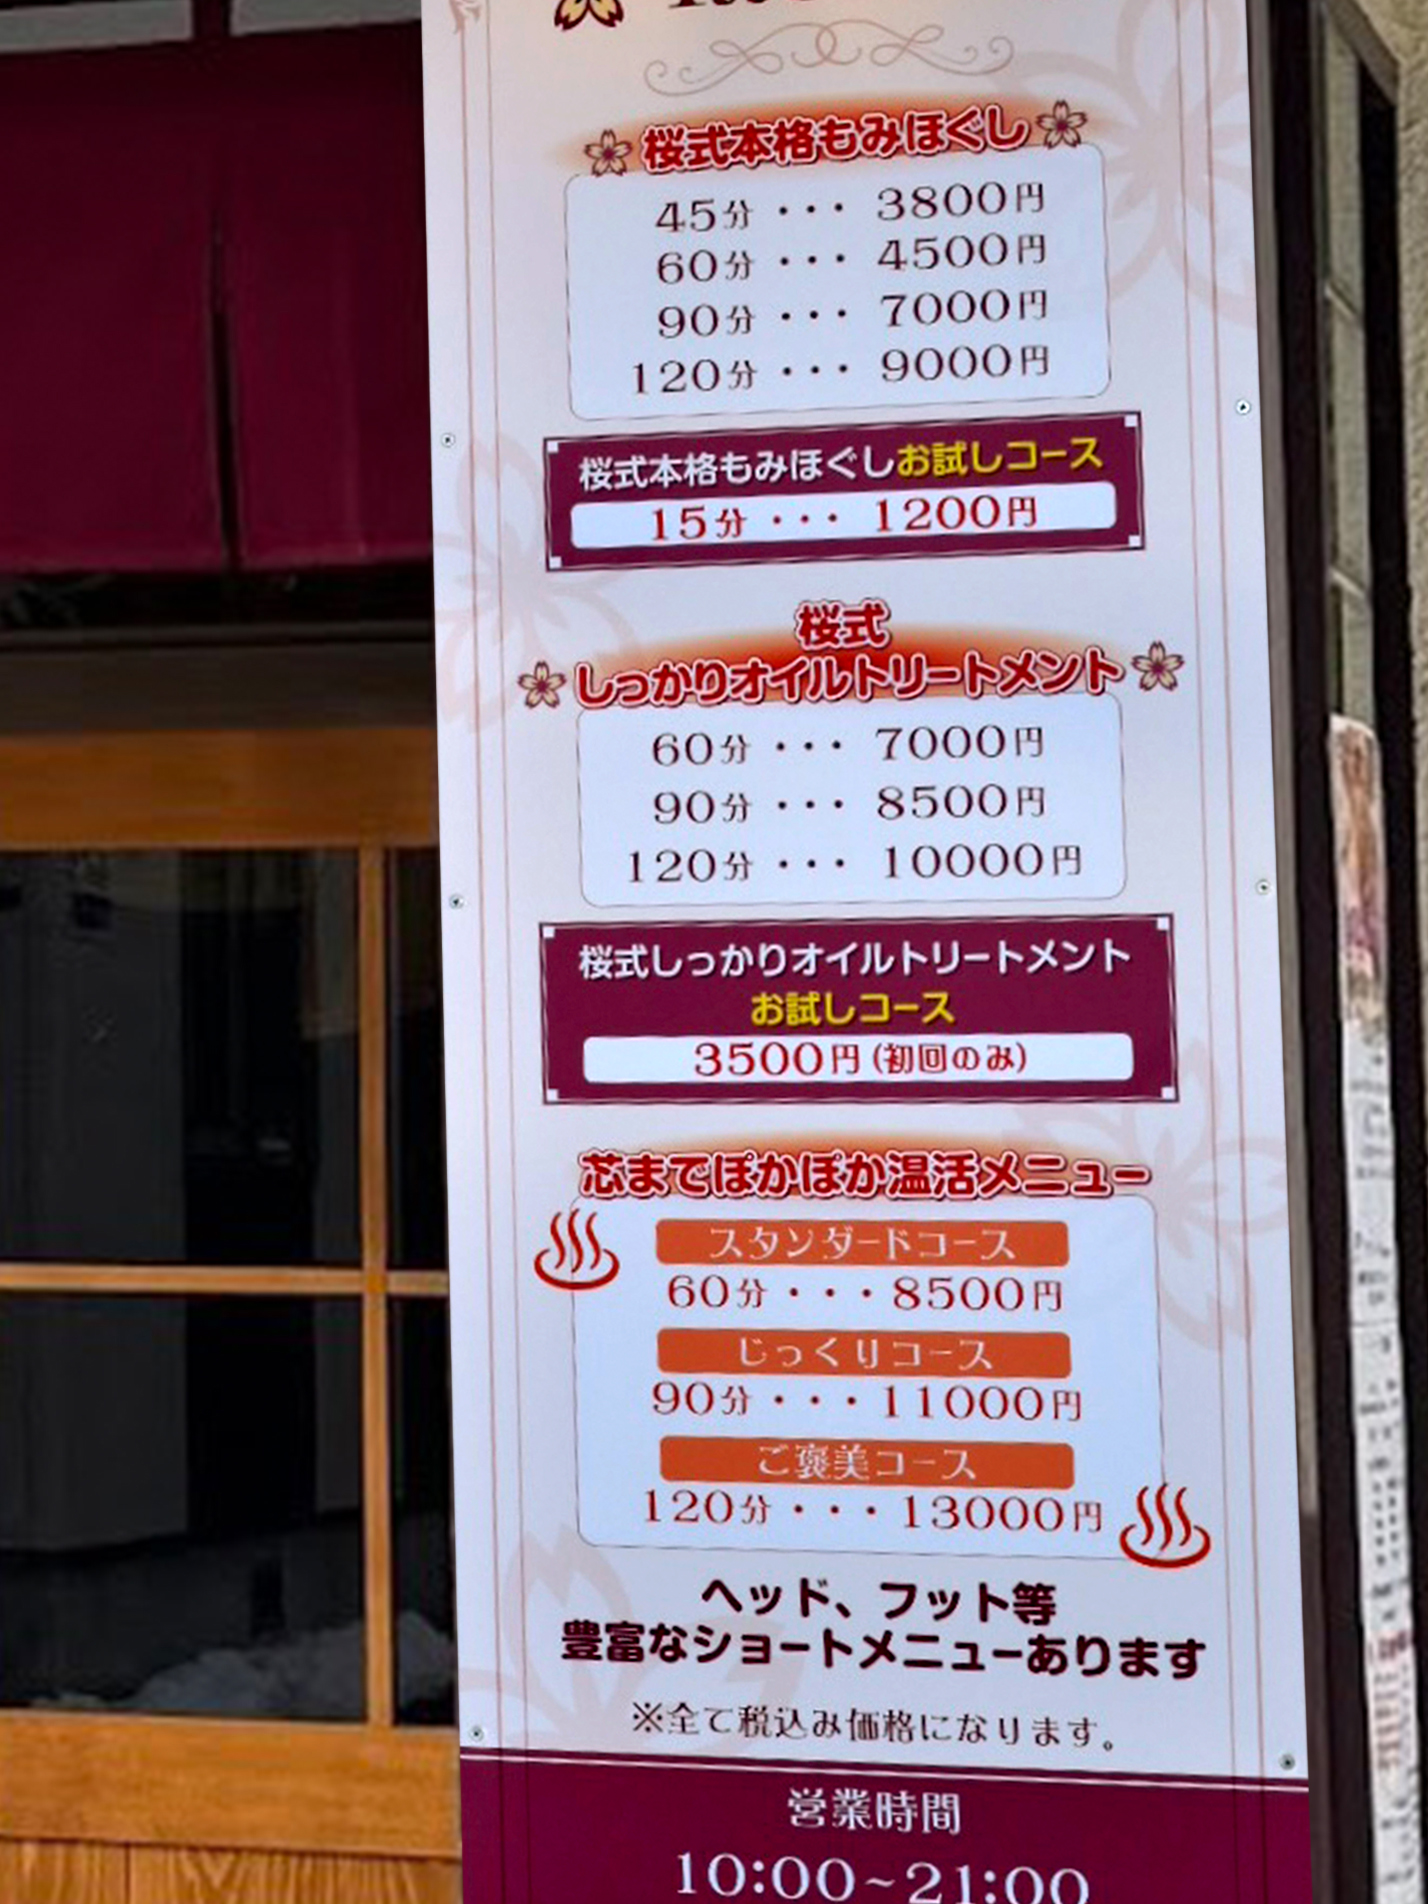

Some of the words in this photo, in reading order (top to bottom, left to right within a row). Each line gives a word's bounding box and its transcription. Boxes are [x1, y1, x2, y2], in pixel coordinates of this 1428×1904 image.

[645, 103, 1031, 170] 桜式本格もみほぐし
[796, 601, 889, 649] 桜式
[575, 649, 1124, 707] しっかりオイルトリートメント
[579, 939, 1129, 979] 桜式しっかりオイルトリートメント
[751, 991, 954, 1025] お試しコース
[579, 1150, 1151, 1199] 芯までぽかぽか温活メニュー
[711, 1226, 1015, 1260] スタンダードコース
[741, 1338, 992, 1374] じっくりコース
[756, 1445, 977, 1481] ご褒美コース
[562, 1622, 1205, 1680] 豊富なショートメニューあります
[788, 1788, 960, 1834] 営業時間
